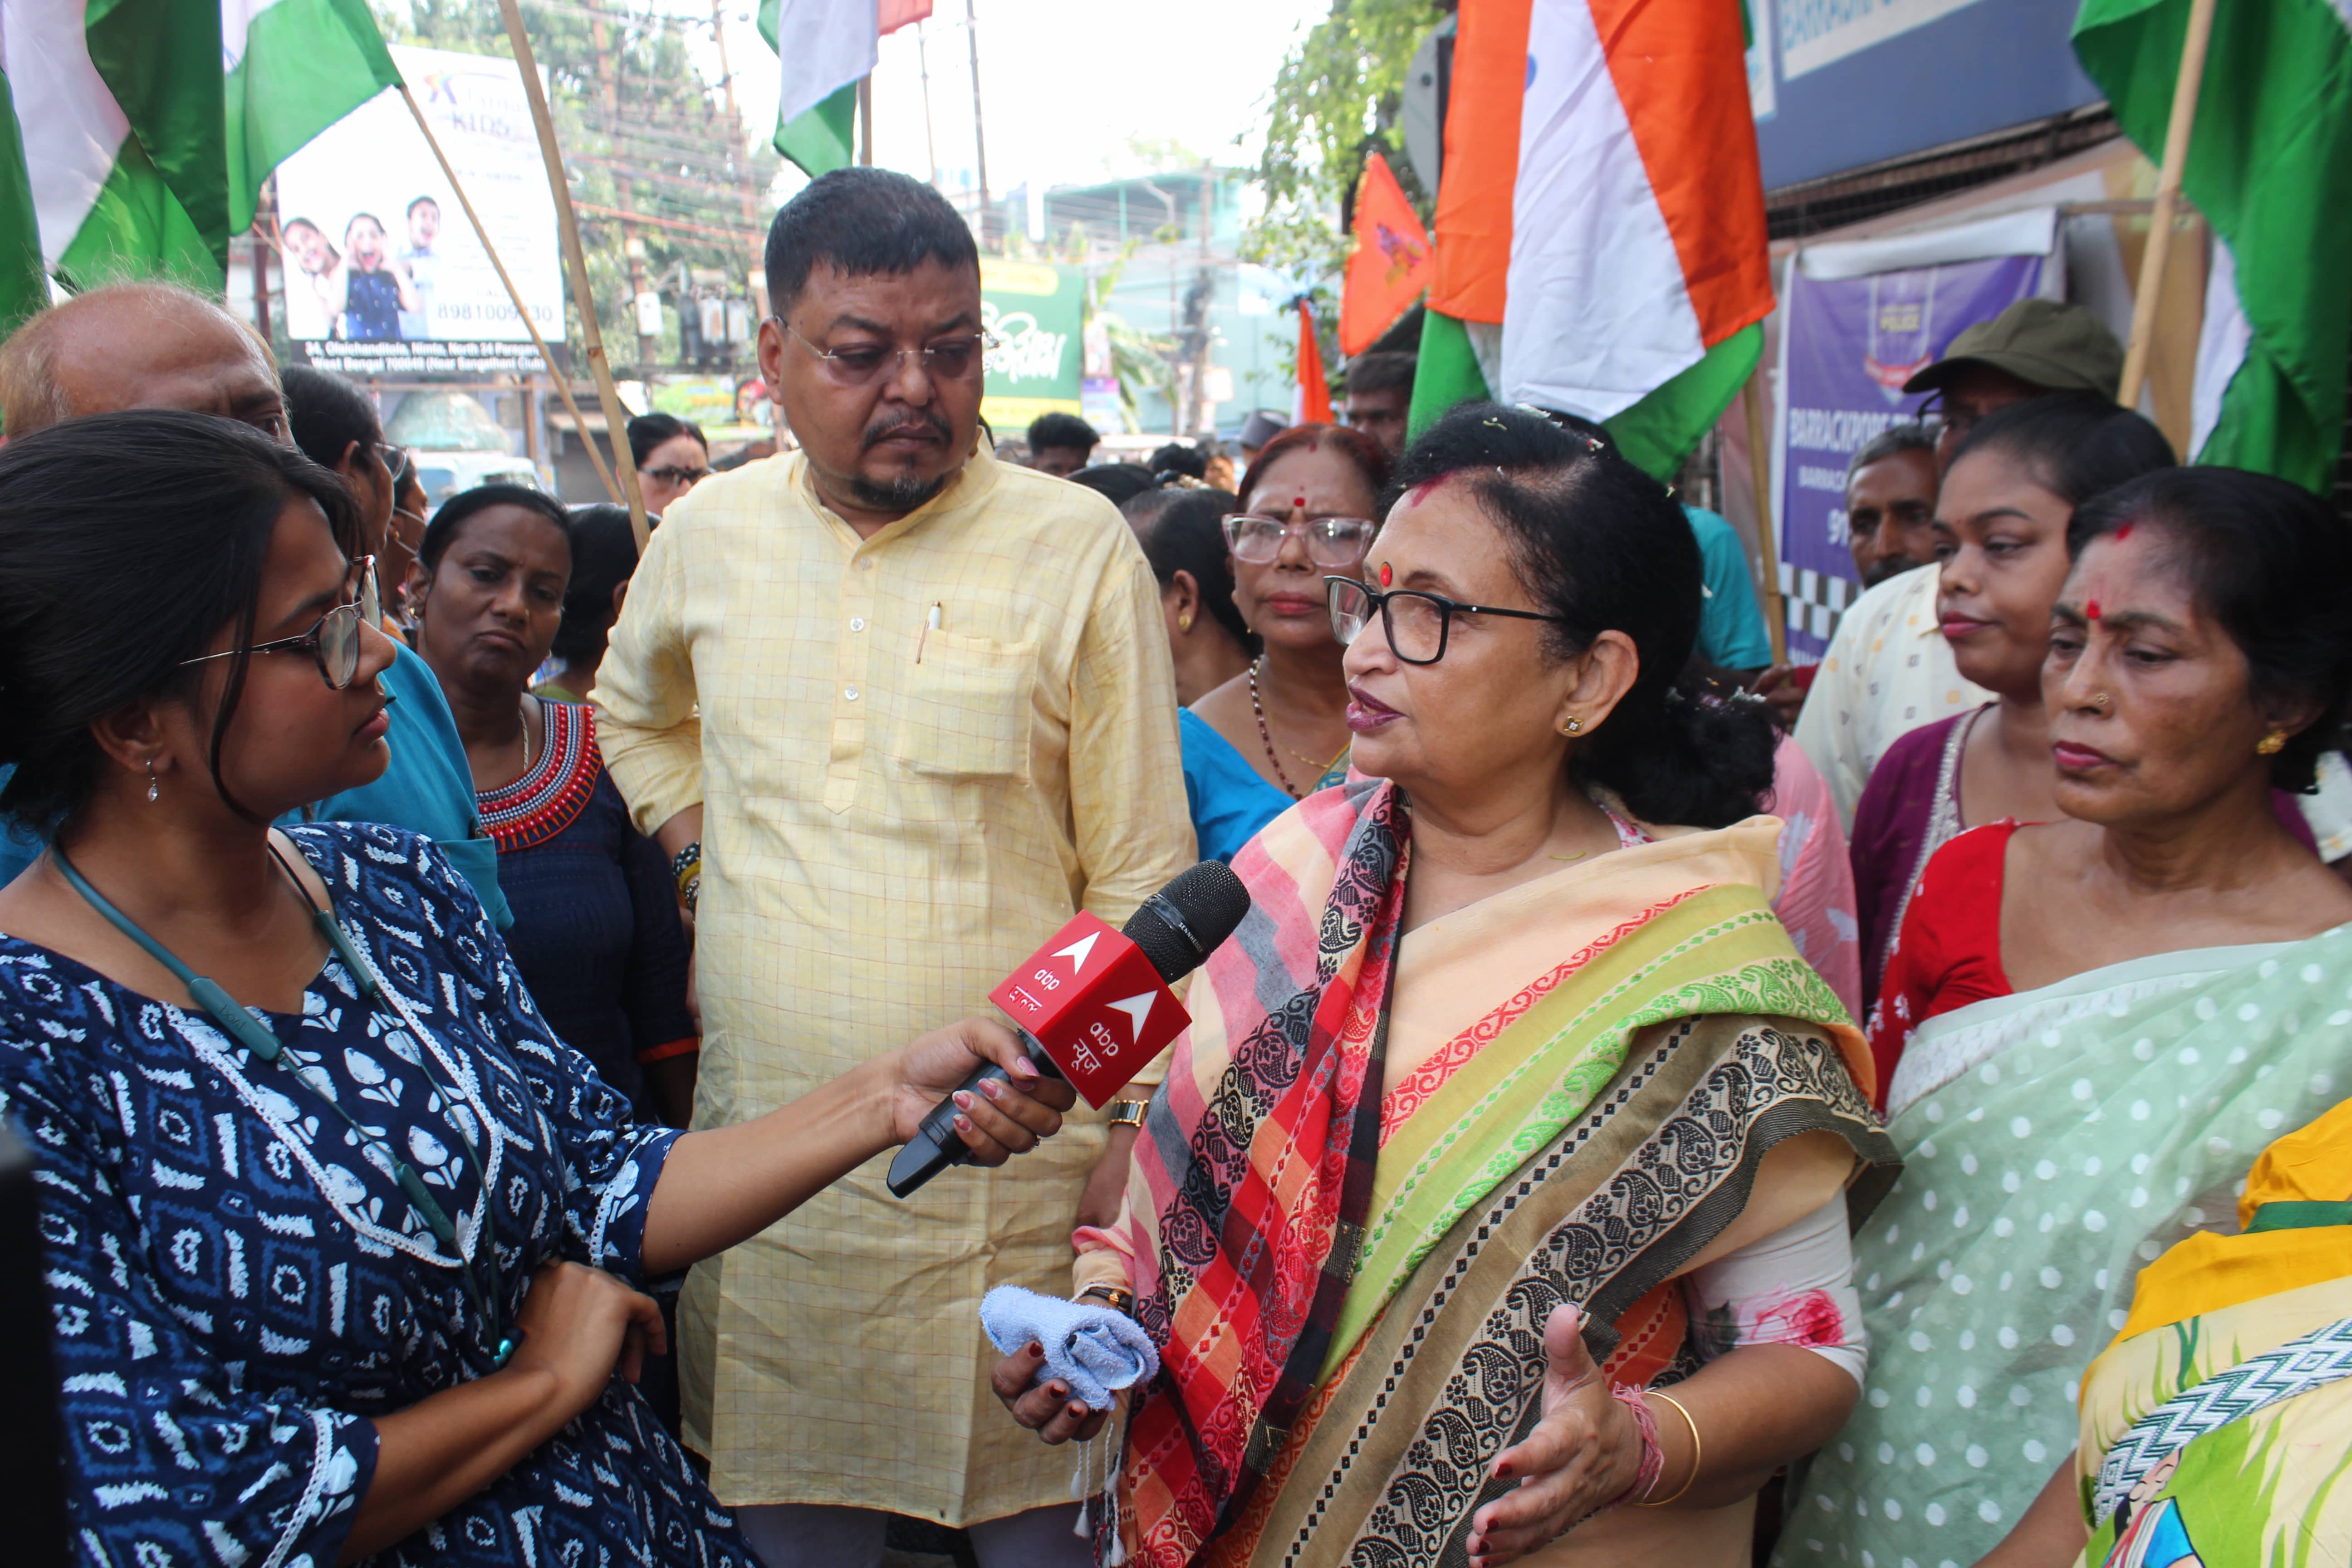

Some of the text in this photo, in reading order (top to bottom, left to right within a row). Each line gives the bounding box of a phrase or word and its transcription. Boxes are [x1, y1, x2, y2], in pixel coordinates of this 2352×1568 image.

[437, 302, 554, 322] 898100930
[343, 358, 384, 373] Bengal
[1798, 466, 1847, 493] BARRAC
[1178, 922, 1204, 952] SENNHEISER
[1034, 968, 1060, 991] abp
[1090, 1022, 1119, 1057] abp
